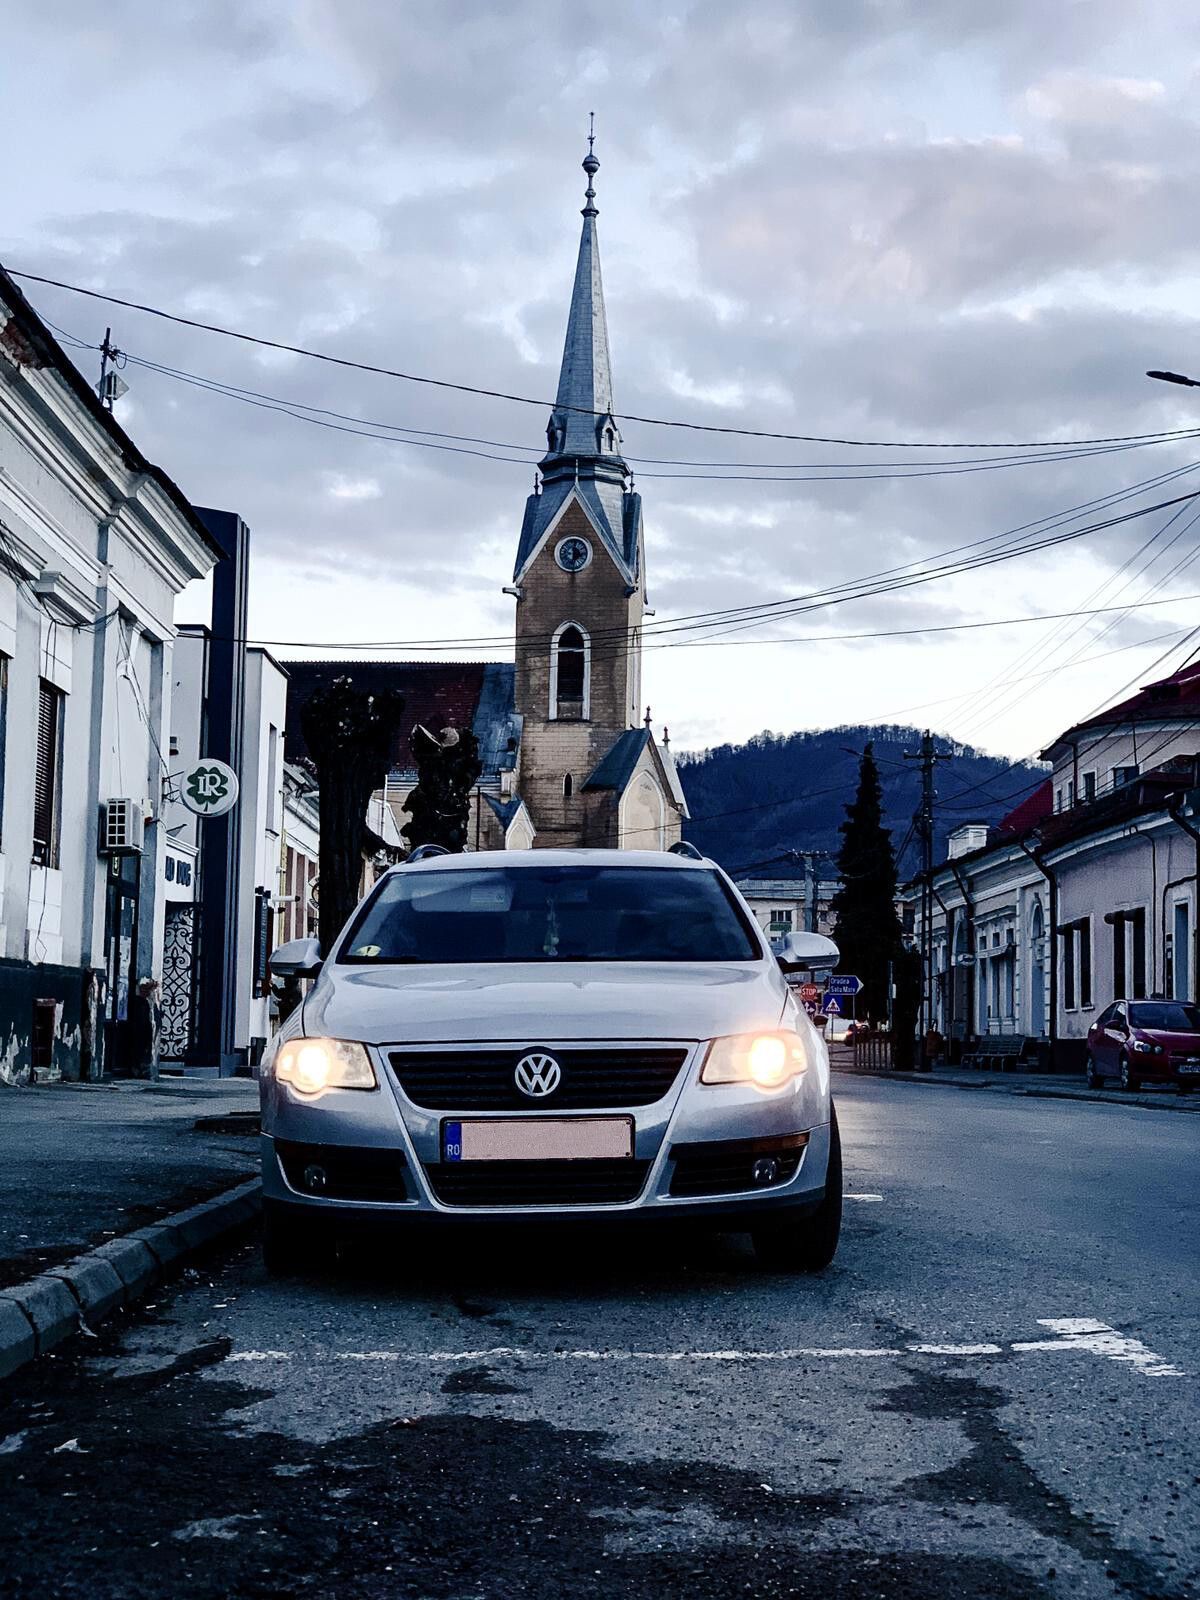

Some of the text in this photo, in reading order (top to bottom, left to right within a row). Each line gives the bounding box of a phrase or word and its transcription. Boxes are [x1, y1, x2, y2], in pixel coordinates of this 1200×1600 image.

[802, 988, 817, 996] STOP
[831, 985, 842, 993] Satu
[515, 1053, 561, 1097] VW
[447, 1143, 460, 1156] RO
